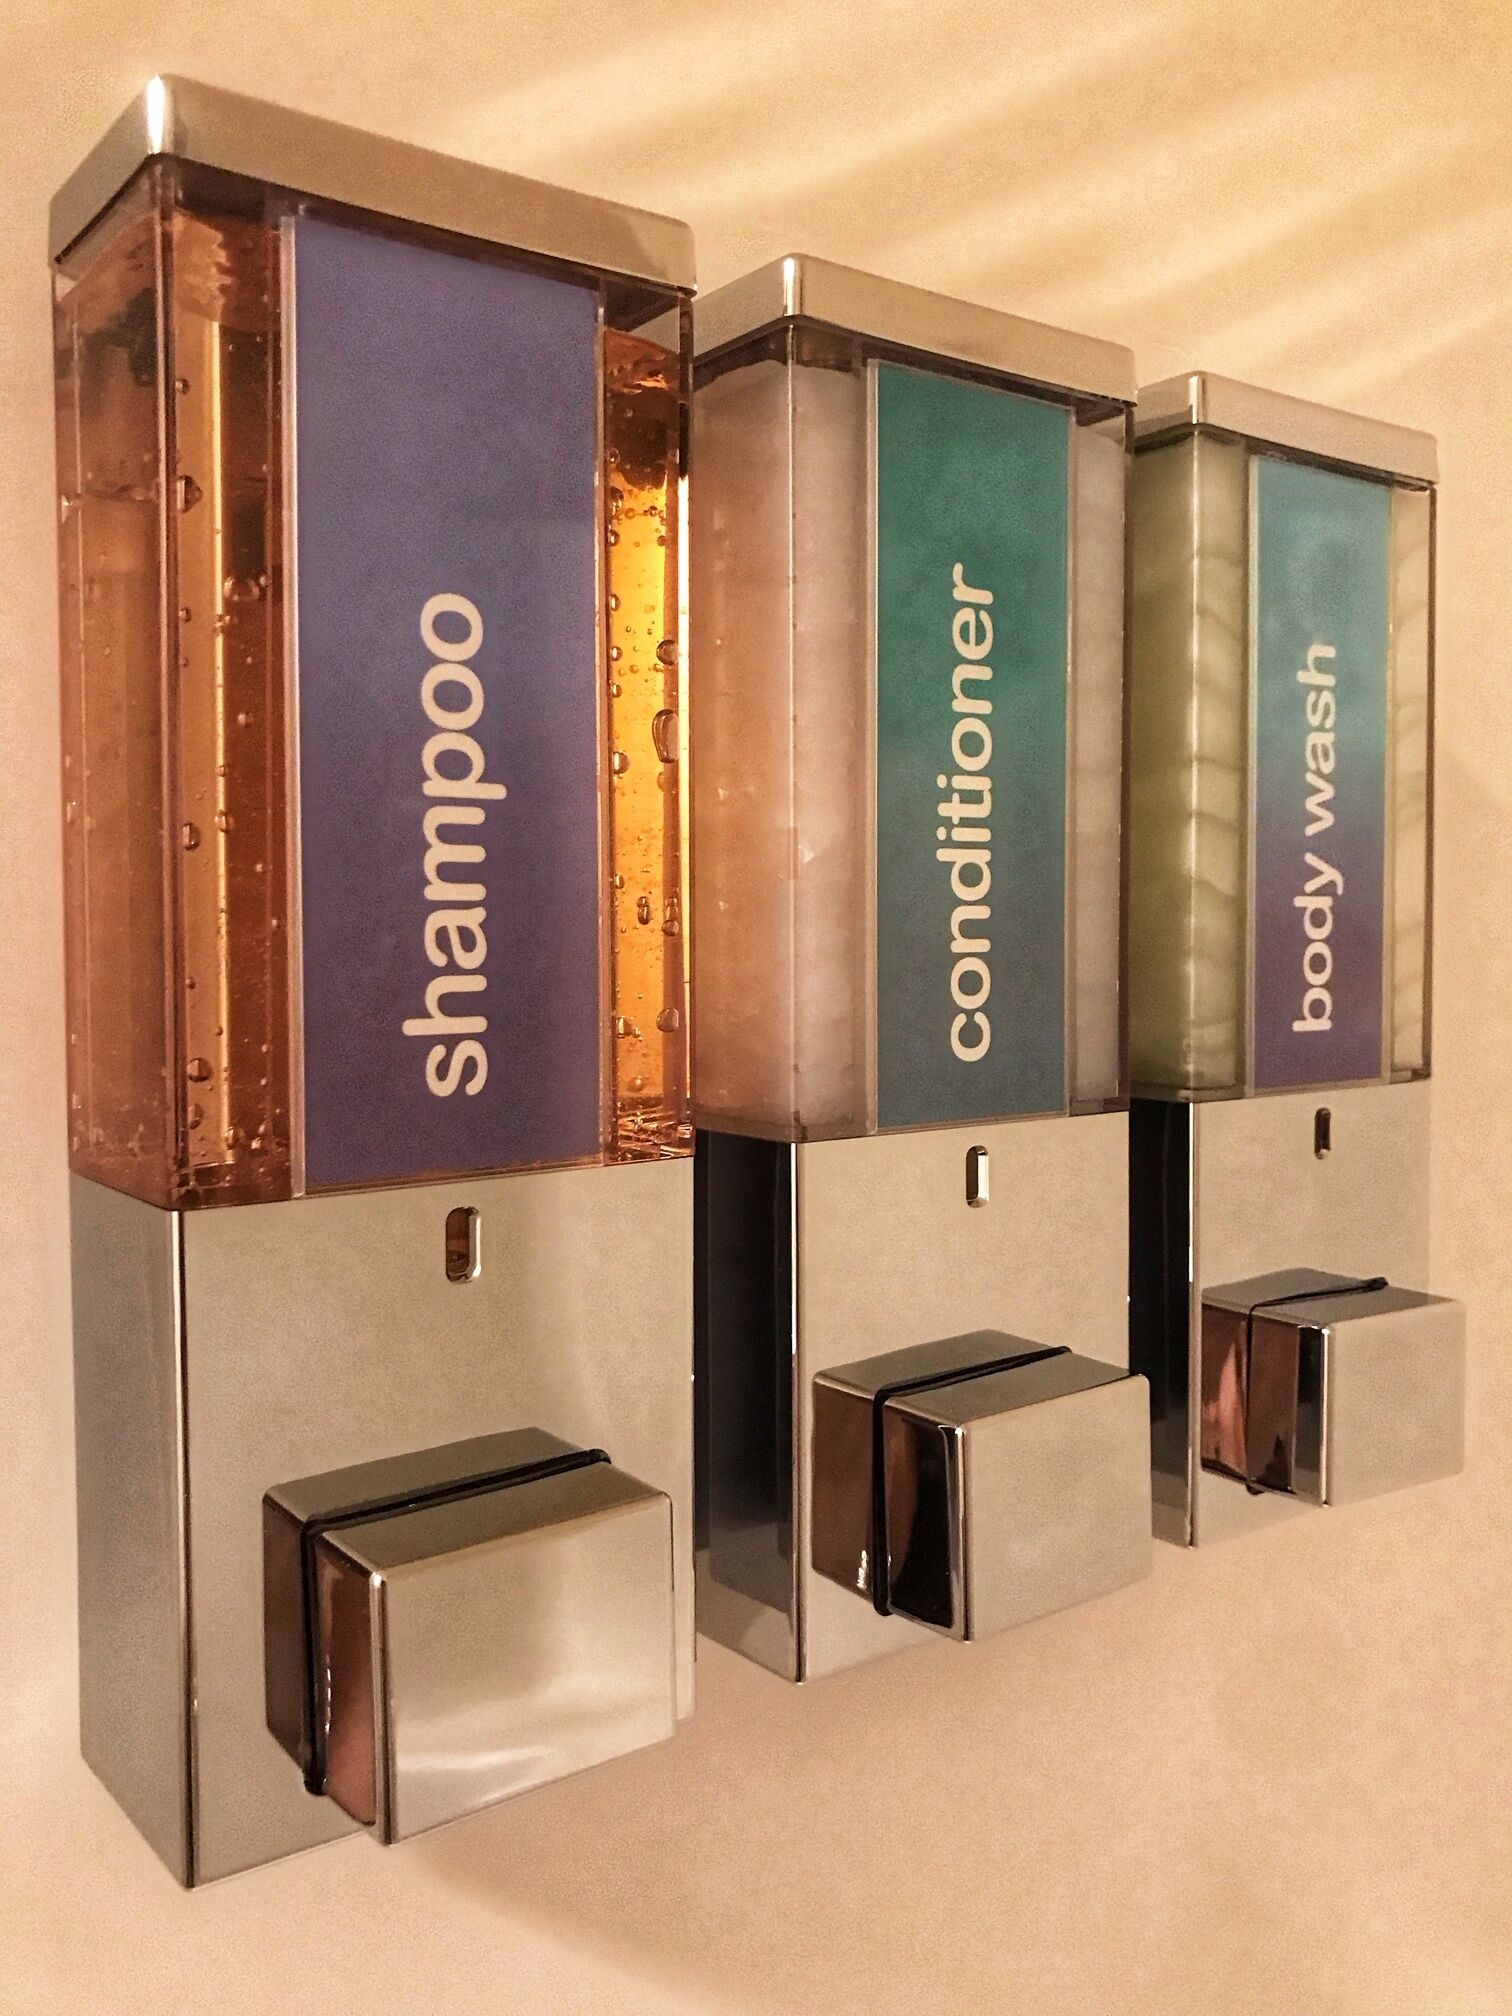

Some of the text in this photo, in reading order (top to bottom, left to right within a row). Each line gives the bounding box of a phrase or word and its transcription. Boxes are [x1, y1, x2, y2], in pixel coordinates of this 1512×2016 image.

[401, 592, 508, 1097] shampoo
[935, 562, 994, 1062] conditioner
[1291, 642, 1345, 1033] body wash
